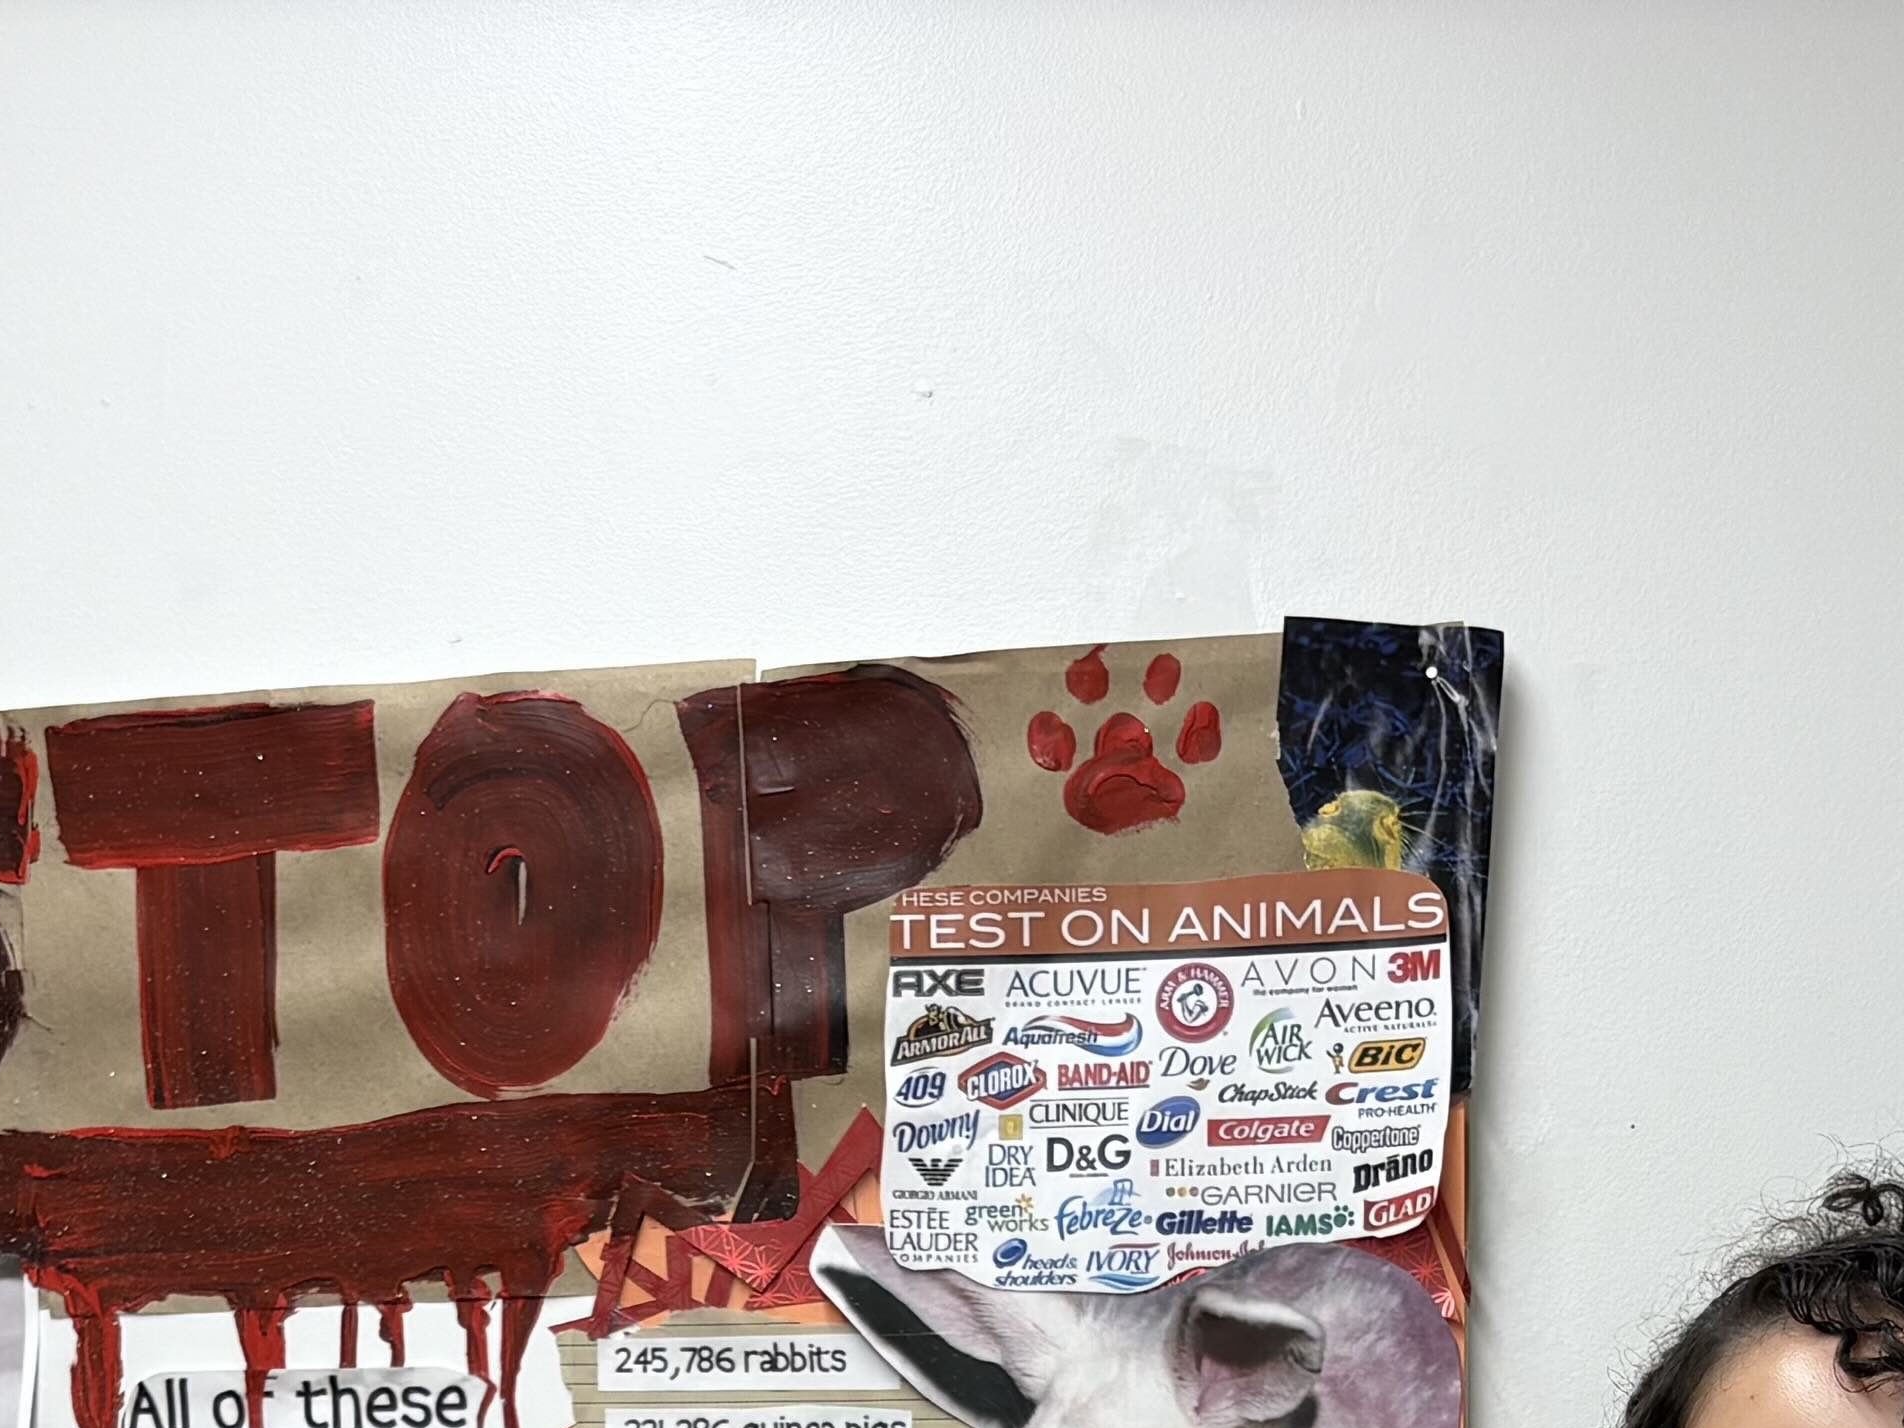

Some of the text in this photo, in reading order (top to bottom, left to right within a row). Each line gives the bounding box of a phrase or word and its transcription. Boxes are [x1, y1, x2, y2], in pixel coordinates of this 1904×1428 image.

[969, 888, 1108, 906] COMPANIES
[890, 892, 1445, 950] TEST ON ANIMALS
[1241, 954, 1376, 988] AVON
[1387, 949, 1441, 984] 3M
[893, 968, 1142, 998] AXE ACUVUE
[1058, 1061, 1151, 1086] BAND-AID
[1157, 1046, 1237, 1077] Dove
[896, 1071, 945, 1101] 409
[966, 1062, 1035, 1101] CLOROX
[1325, 1078, 1438, 1105] Crest
[1029, 1102, 1129, 1126] CLINIQUE
[1141, 1110, 1195, 1133] Dial
[894, 1110, 980, 1152] Downy
[1218, 1120, 1315, 1141] Colgate
[1332, 1126, 1420, 1153] Coppertone
[989, 1144, 1033, 1166] DRY
[1047, 1134, 1131, 1173] D&G
[1165, 1154, 1331, 1177] Elizabeth Arden
[986, 1167, 1036, 1187] IDEA
[966, 1205, 1023, 1225] green
[1369, 1193, 1431, 1226] GLAD
[988, 1215, 1049, 1232] works
[1156, 1210, 1253, 1235] Gillette
[1266, 1213, 1333, 1236] IAMS
[890, 1234, 978, 1252] LAUDER
[1086, 1250, 1160, 1273] IVORY
[615, 1343, 846, 1379] 245,786 rabbits
